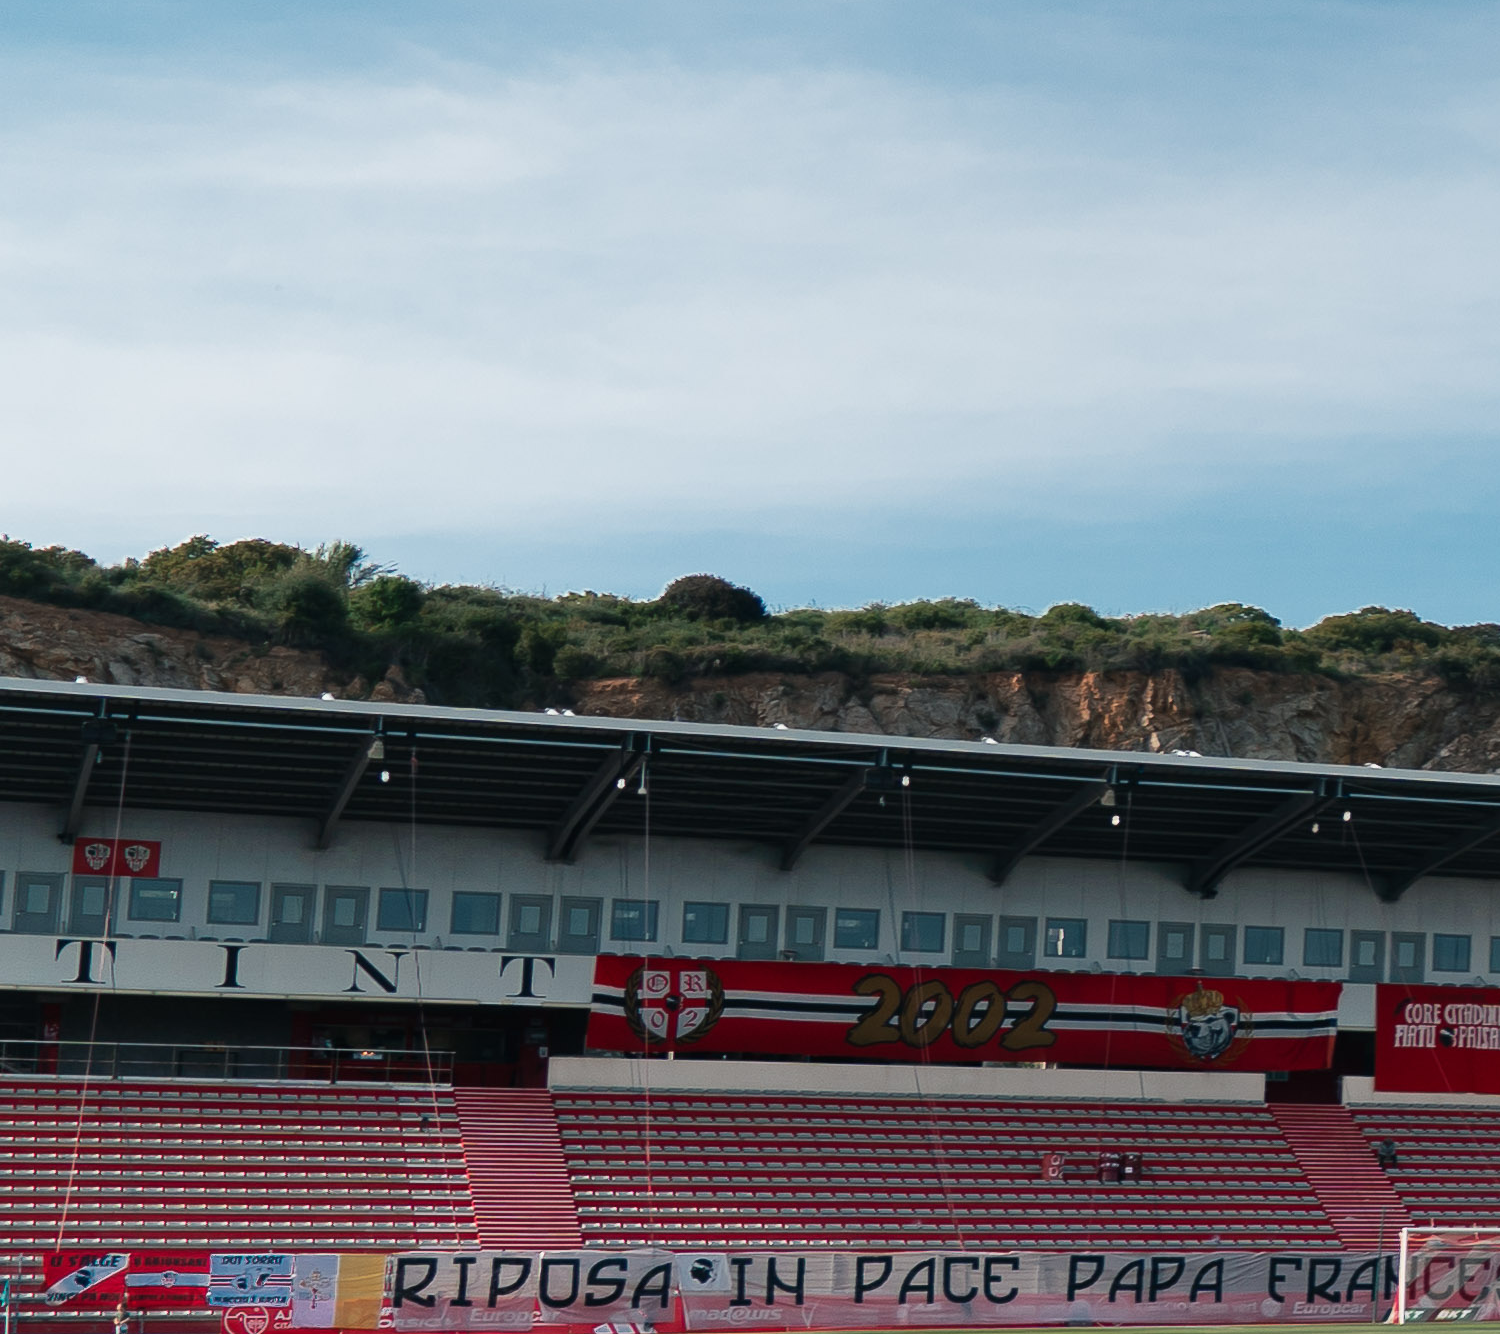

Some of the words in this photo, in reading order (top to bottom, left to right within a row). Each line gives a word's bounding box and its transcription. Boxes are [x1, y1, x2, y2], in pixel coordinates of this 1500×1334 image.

[847, 973, 1057, 1050] 2002
[1404, 1003, 1442, 1025] CORE
[392, 1257, 673, 1309] RIPOSA
[854, 1255, 1020, 1305] PACE
[1066, 1254, 1225, 1304] PAPA
[1292, 1301, 1366, 1316] Europcar
